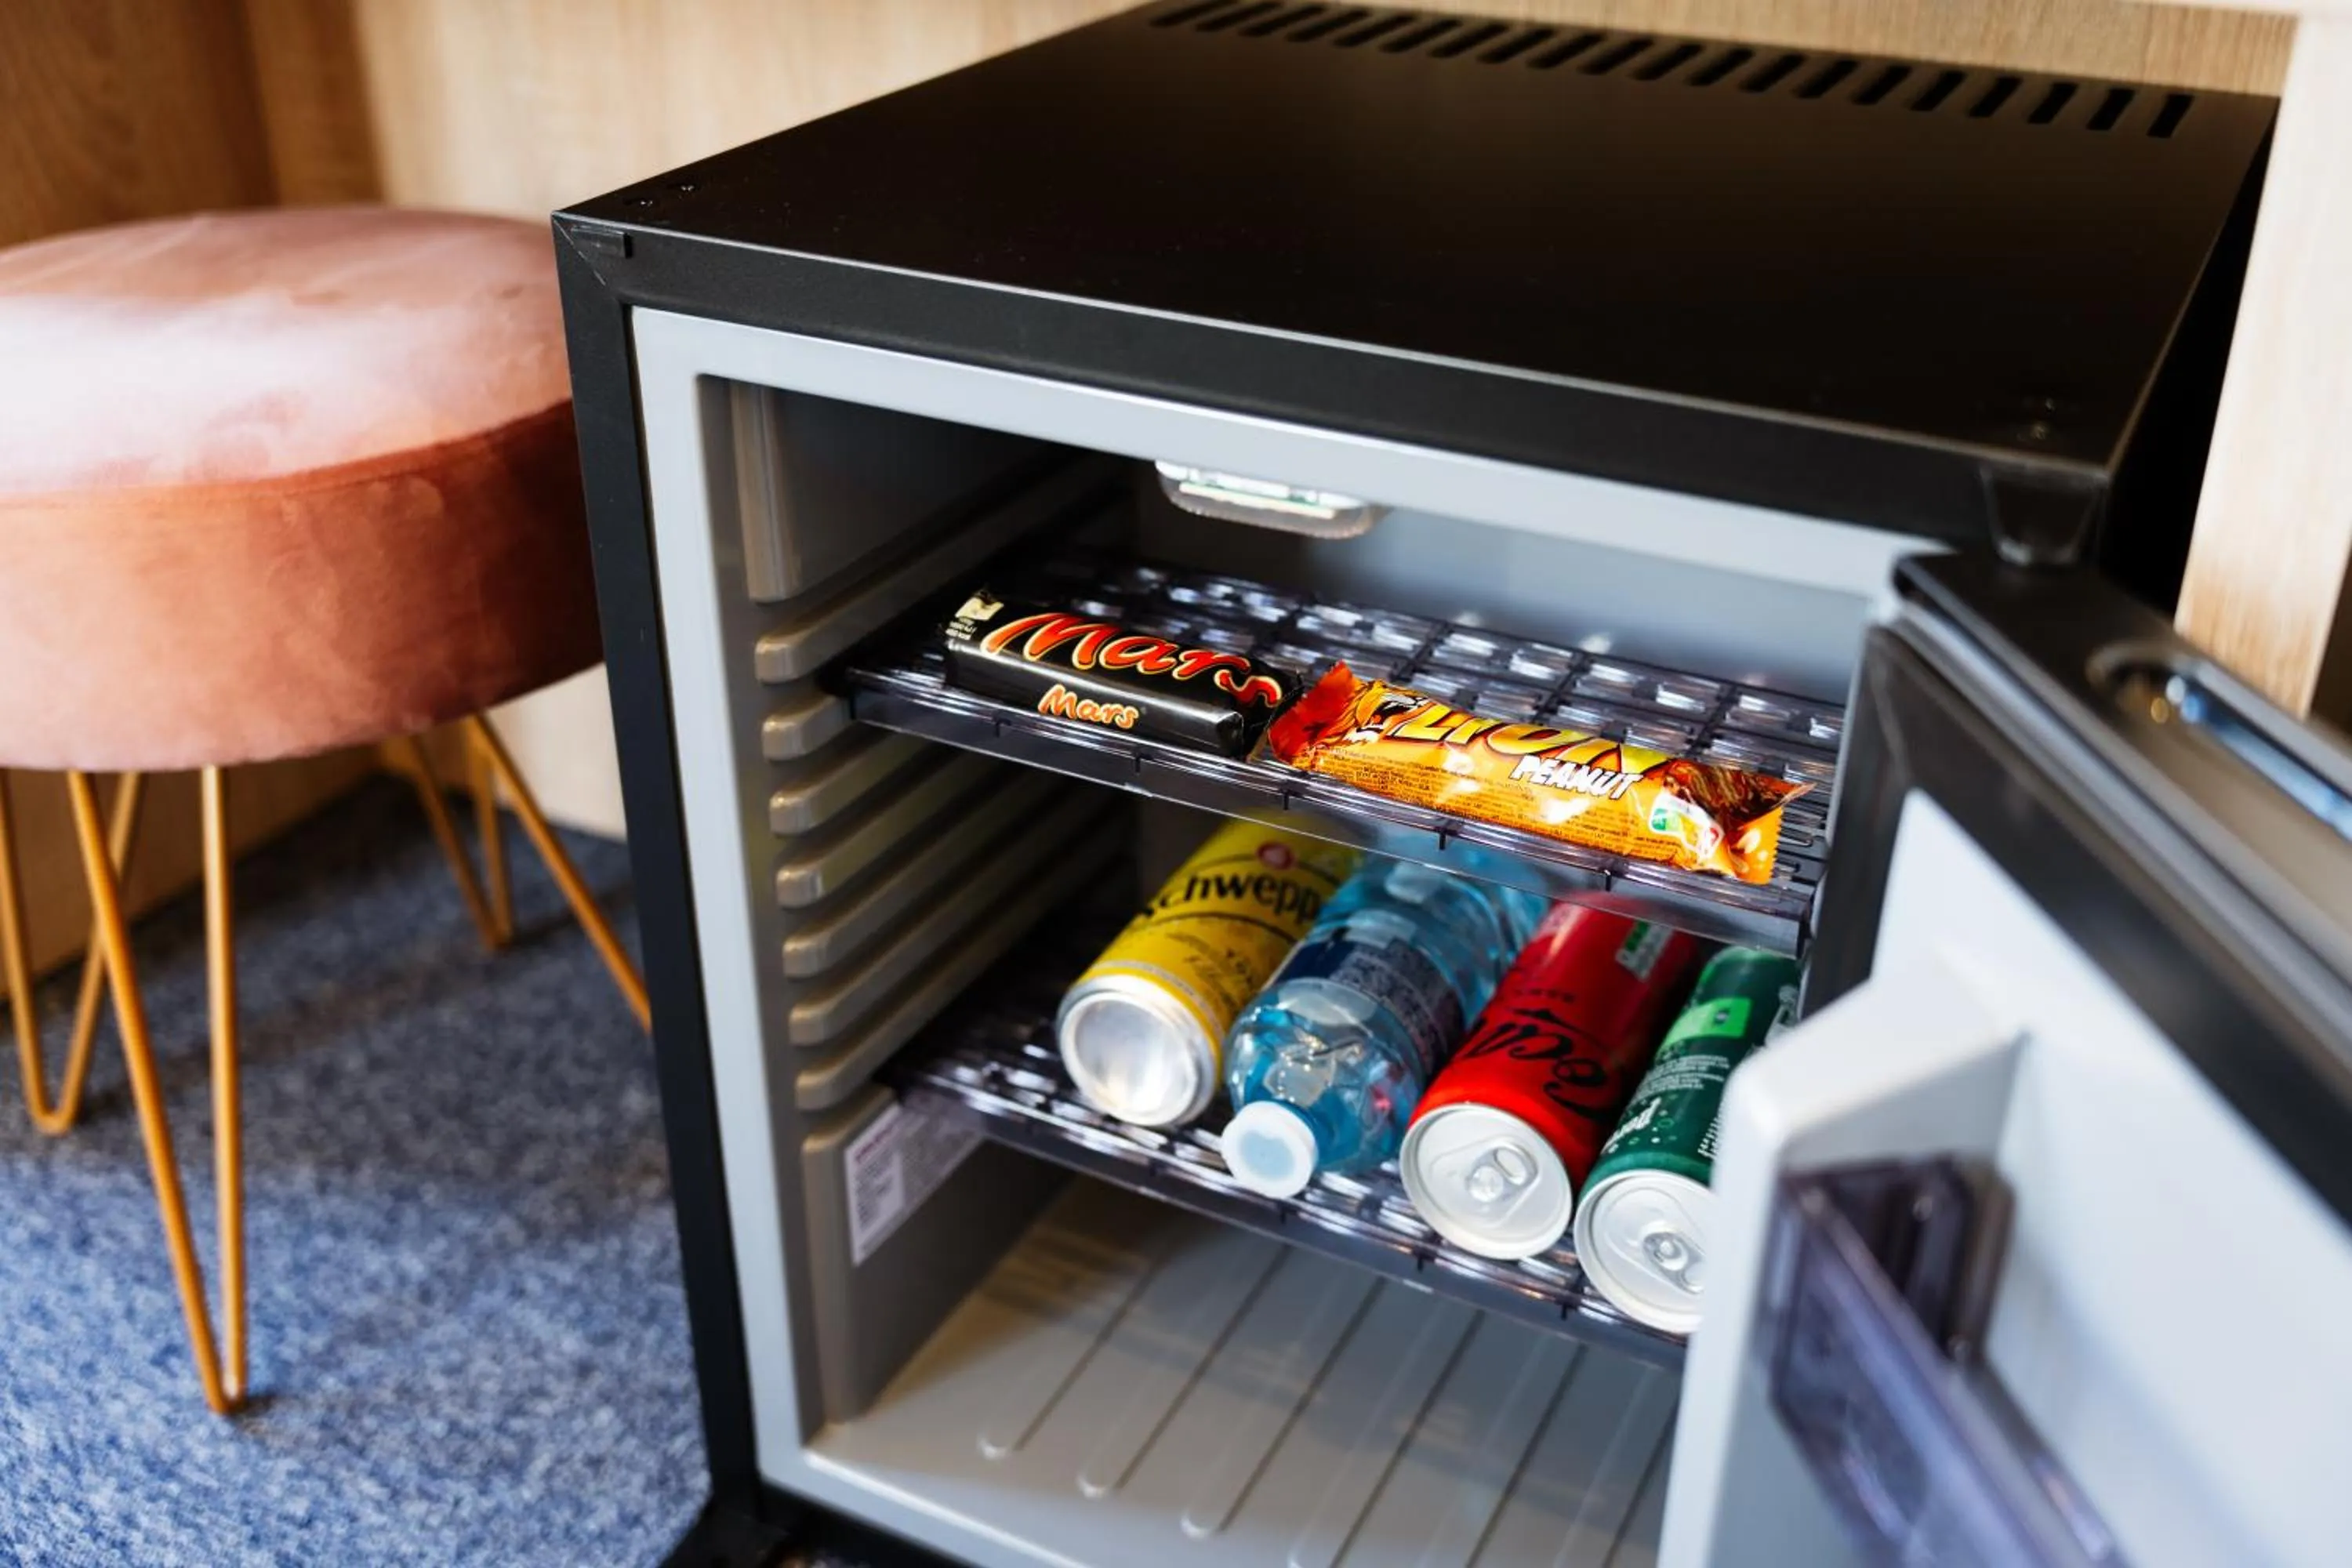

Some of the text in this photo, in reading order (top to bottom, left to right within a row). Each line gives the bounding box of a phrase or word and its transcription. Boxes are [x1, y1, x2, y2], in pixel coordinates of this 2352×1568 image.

[980, 612, 1283, 707] Mars
[1037, 684, 1139, 729] Mars
[1508, 753, 1645, 800] PEANUT
